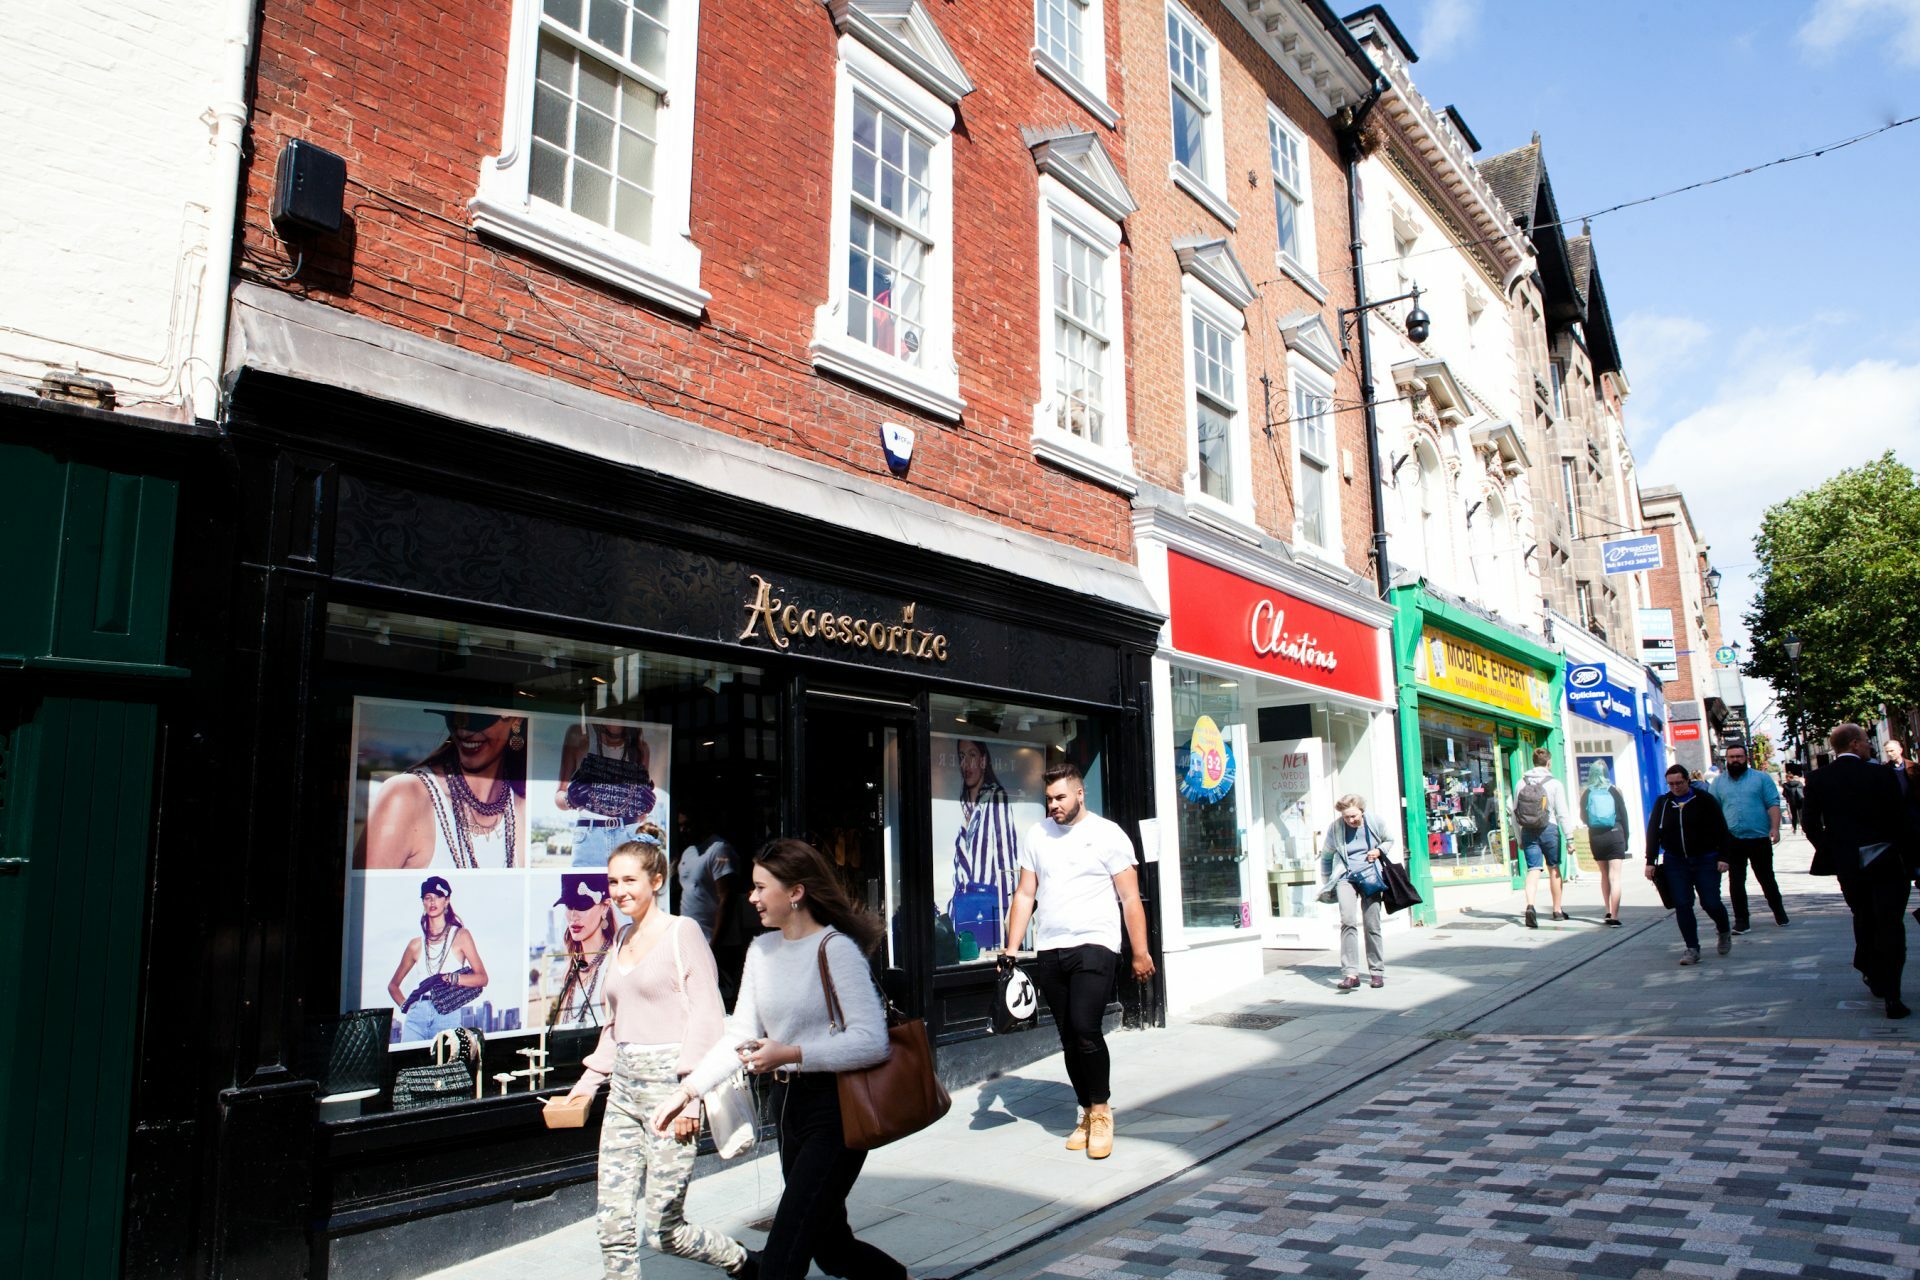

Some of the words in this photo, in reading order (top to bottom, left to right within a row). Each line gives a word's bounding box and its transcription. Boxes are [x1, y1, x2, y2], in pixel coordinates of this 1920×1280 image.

[740, 574, 948, 661] Accessorize
[1251, 599, 1338, 669] Clintons
[1446, 641, 1488, 679] MOBILE
[1490, 658, 1526, 691] EXPERT
[1575, 671, 1598, 684] Boots
[1570, 691, 1606, 700] Opticians
[1281, 771, 1305, 780] WEDD
[1272, 780, 1298, 790] CARDS
